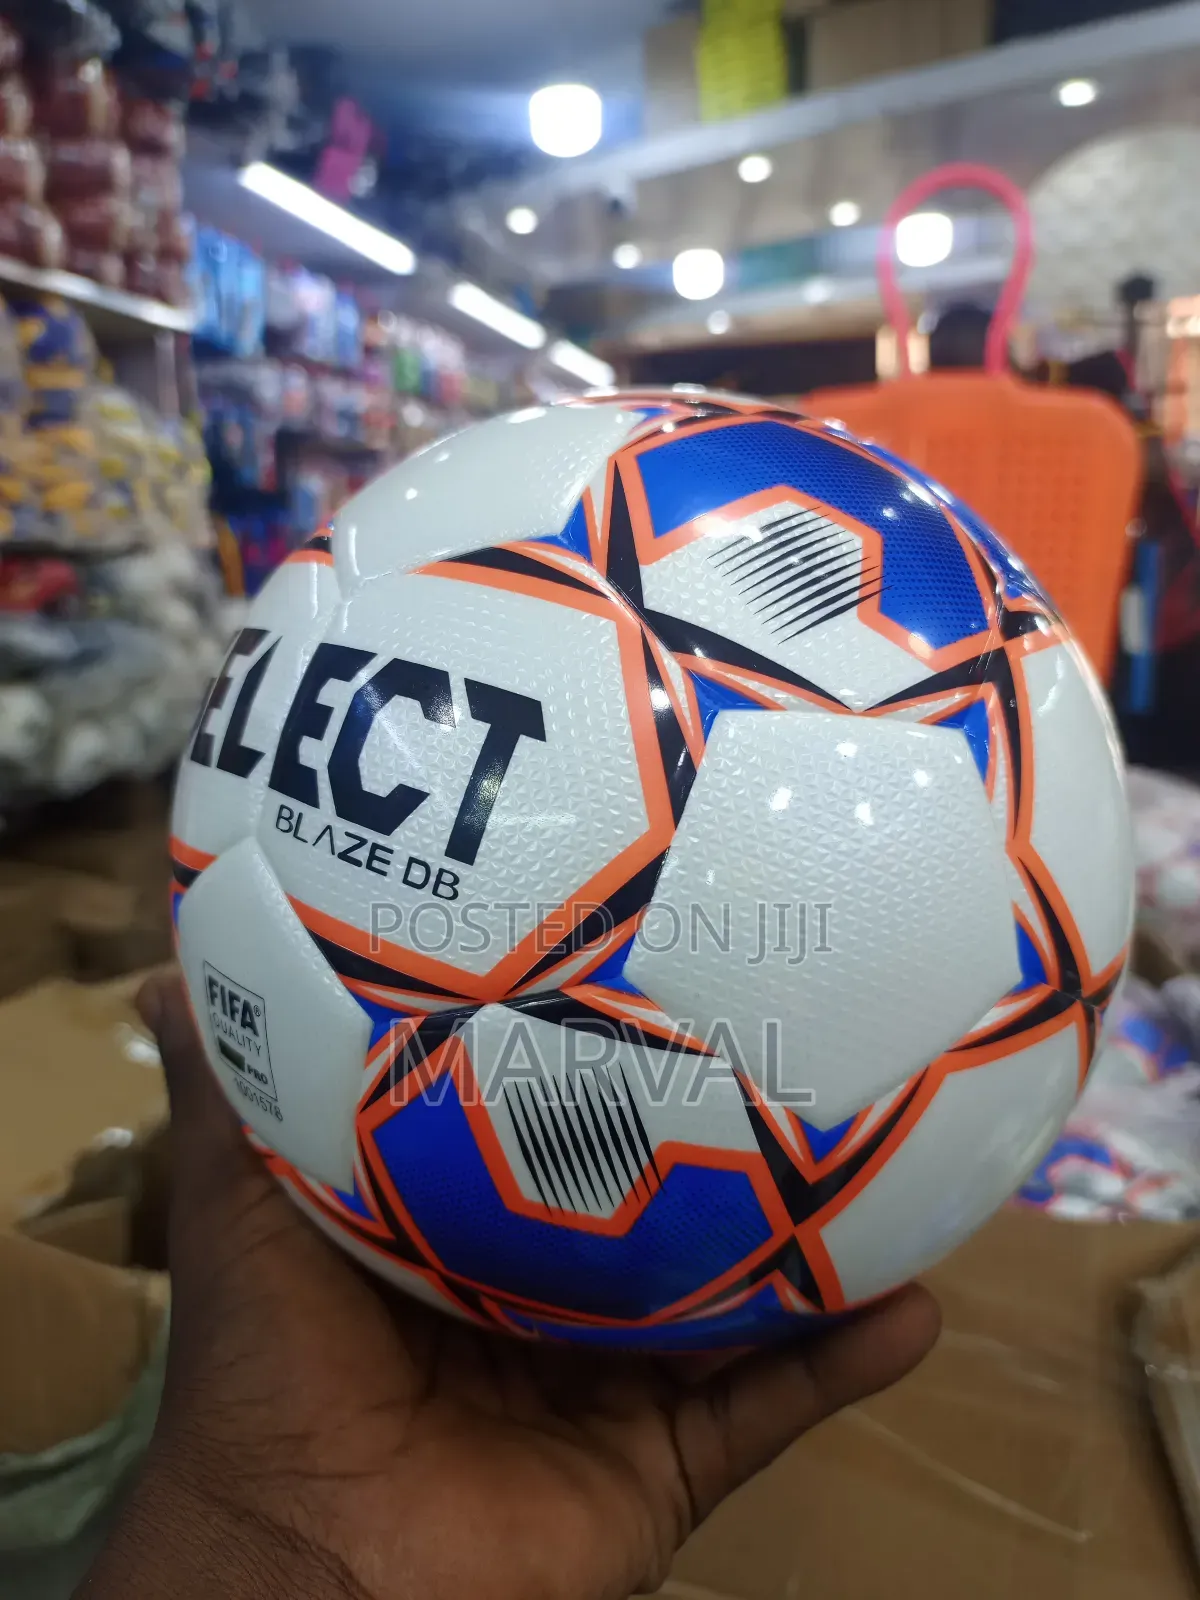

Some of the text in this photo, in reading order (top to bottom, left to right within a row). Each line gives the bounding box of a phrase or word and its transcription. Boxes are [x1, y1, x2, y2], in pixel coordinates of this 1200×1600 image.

[275, 804, 460, 901] BLAZE DB
[211, 1012, 262, 1057] QUALITY
[246, 1063, 269, 1085] PRO
